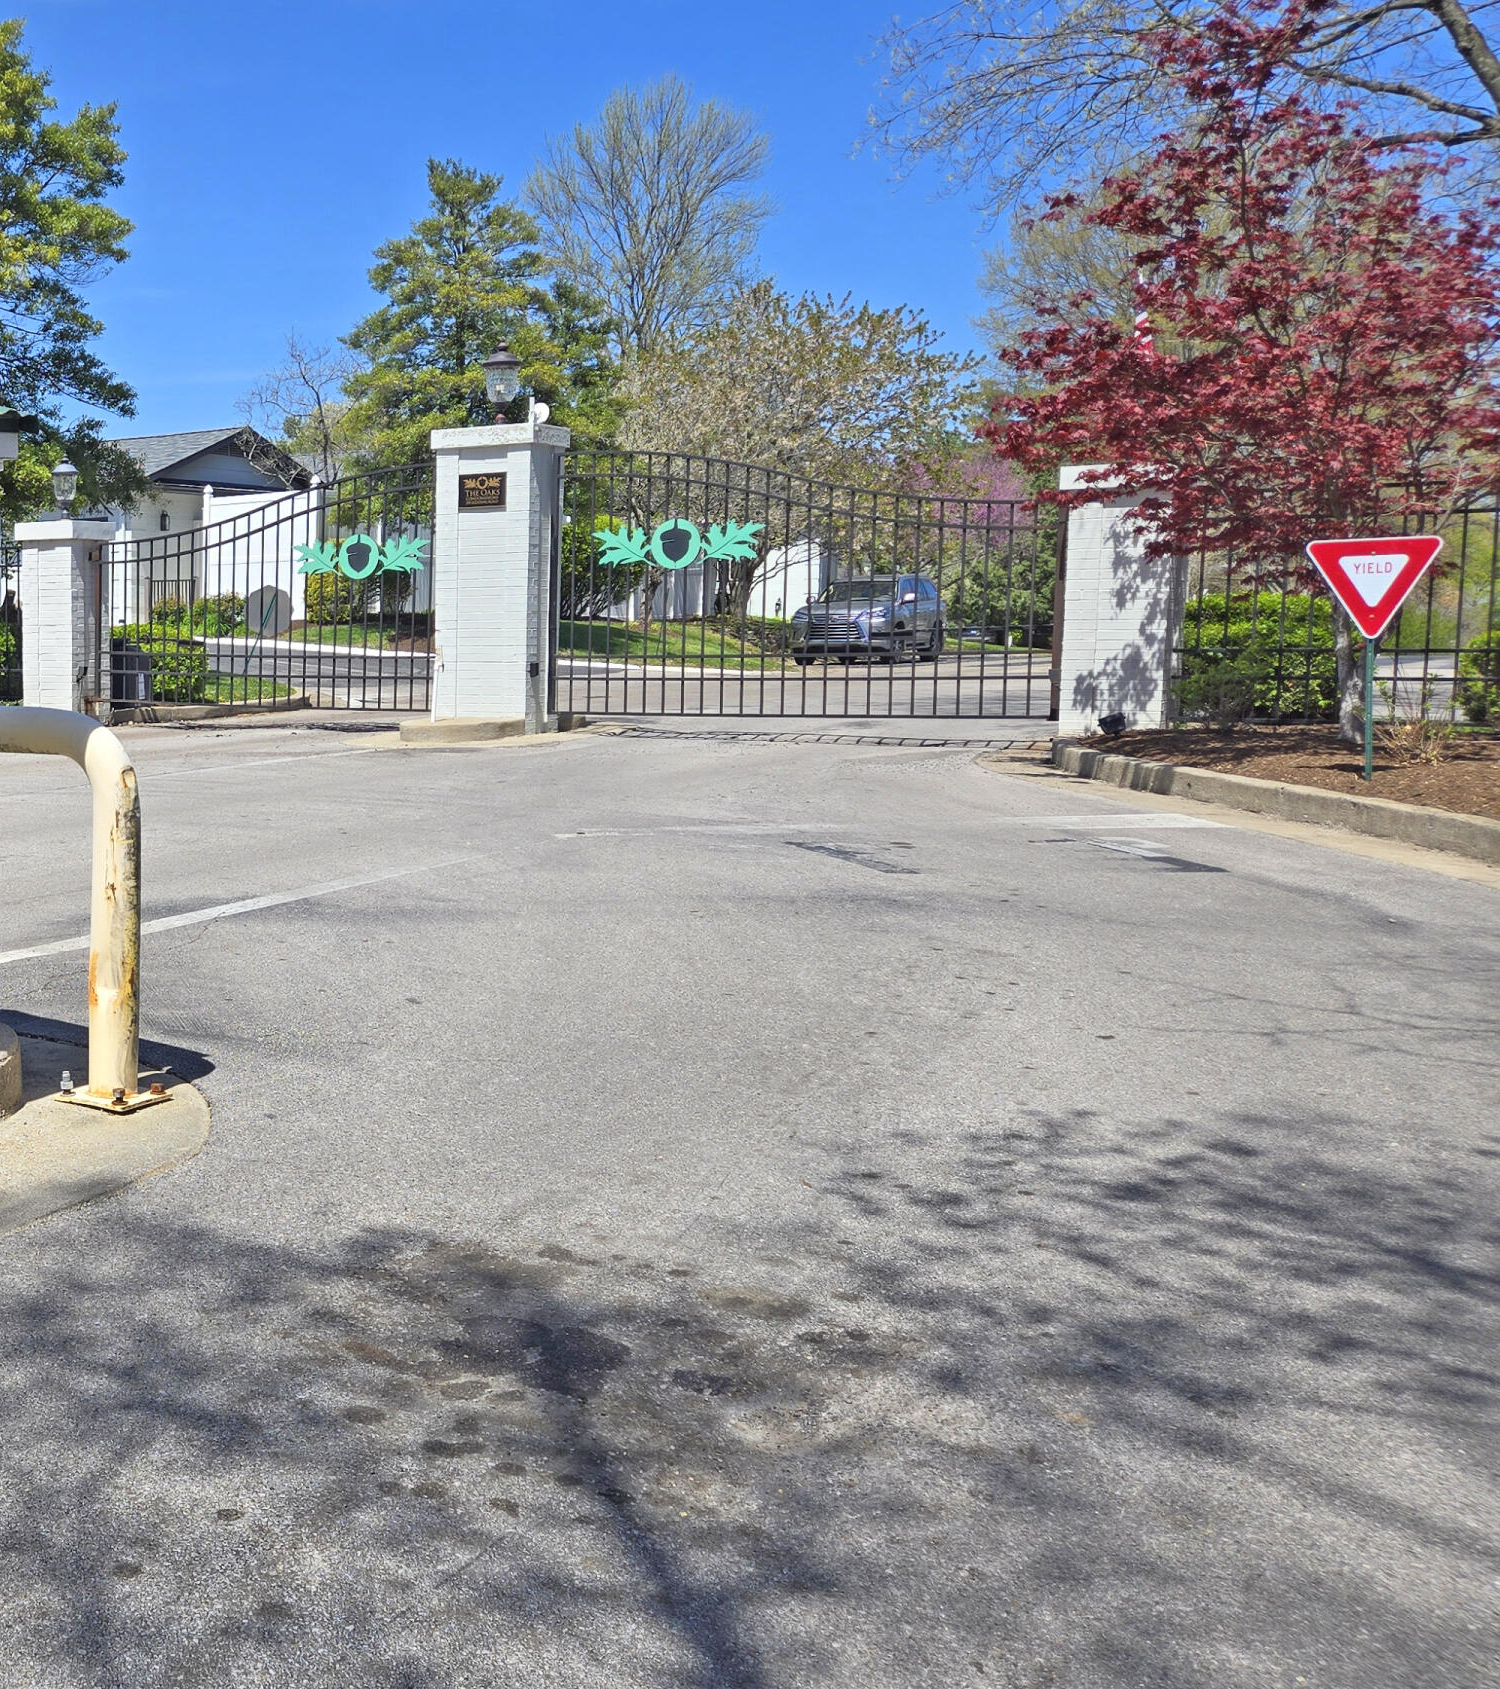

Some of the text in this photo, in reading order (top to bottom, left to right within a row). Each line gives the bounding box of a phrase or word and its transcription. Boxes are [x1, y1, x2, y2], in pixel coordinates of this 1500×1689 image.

[465, 489, 500, 498] THE OAKS
[1354, 562, 1392, 574] YIELD
